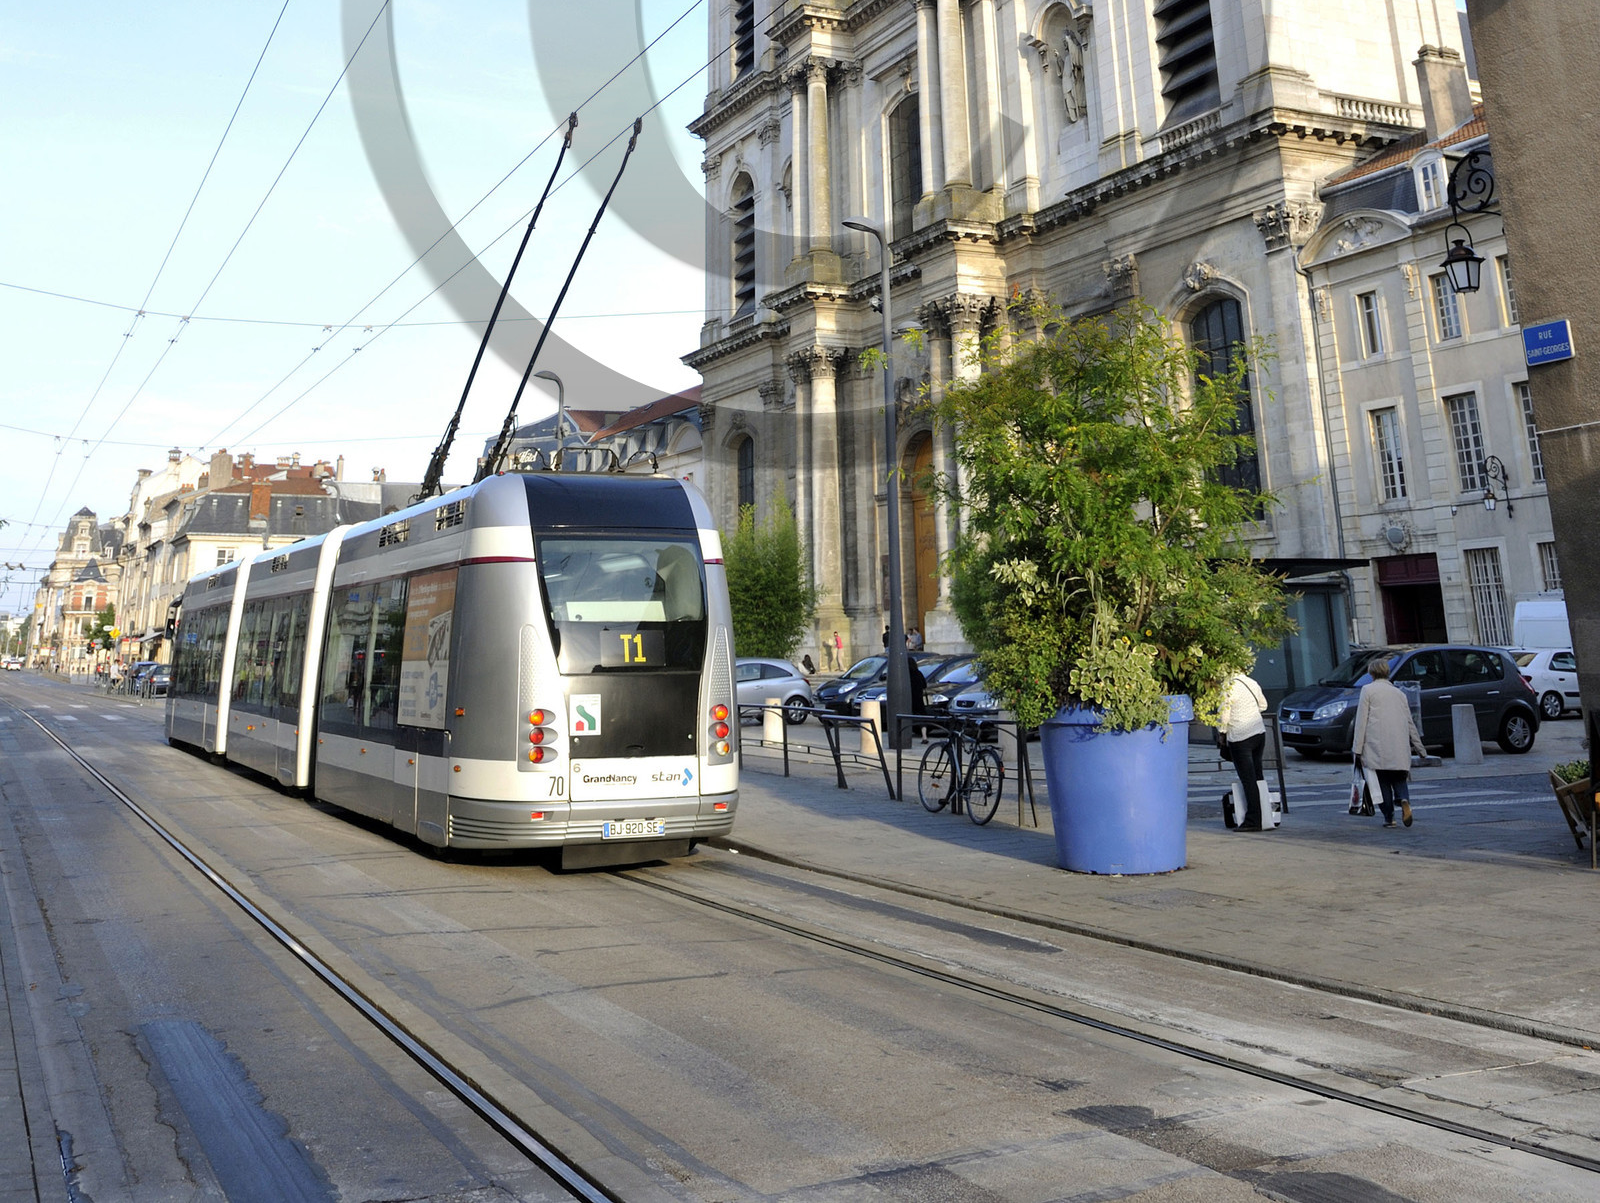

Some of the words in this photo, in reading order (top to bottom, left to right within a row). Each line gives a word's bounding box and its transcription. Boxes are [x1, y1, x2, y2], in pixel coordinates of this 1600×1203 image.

[1538, 329, 1553, 340] RUE
[619, 633, 647, 663] T1
[651, 771, 681, 782] stan
[549, 776, 564, 796] 70
